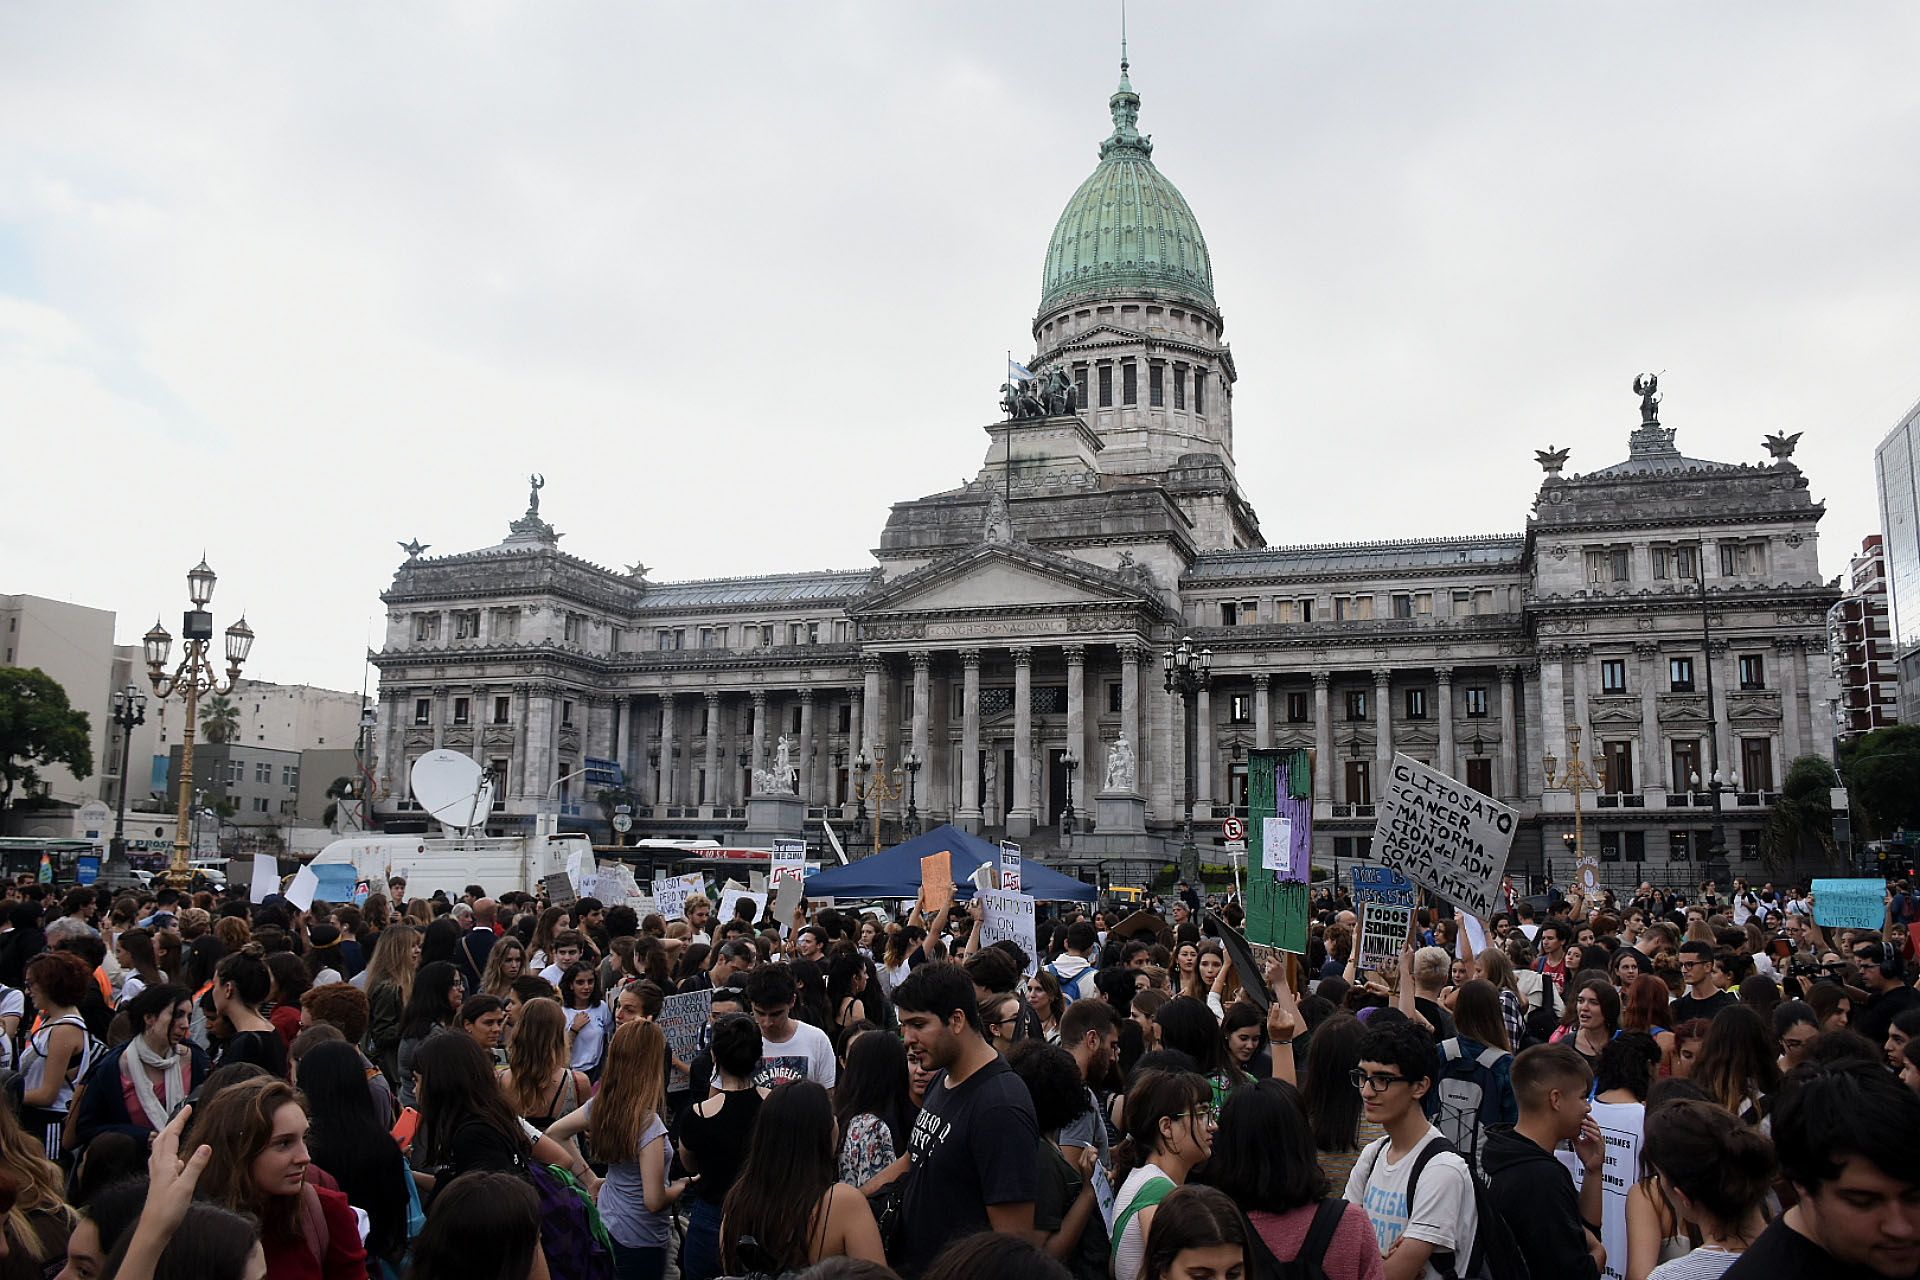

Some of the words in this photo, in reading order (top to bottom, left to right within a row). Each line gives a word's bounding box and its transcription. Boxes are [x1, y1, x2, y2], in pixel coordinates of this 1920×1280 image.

[936, 625, 996, 635] CONGRESO
[1002, 621, 1057, 633] NACIONAL
[1394, 765, 1512, 834] GLIFOSATO
[1434, 843, 1456, 862] del
[1460, 855, 1493, 880] ADN
[652, 880, 665, 892] NO
[666, 877, 680, 889] SOY
[985, 894, 1020, 915] CLIMA
[1366, 908, 1408, 923] TODOS
[1823, 917, 1870, 928] NUESTRO
[997, 917, 1014, 932] NO
[1365, 921, 1407, 938] SOMOS
[754, 1071, 770, 1085] LOS
